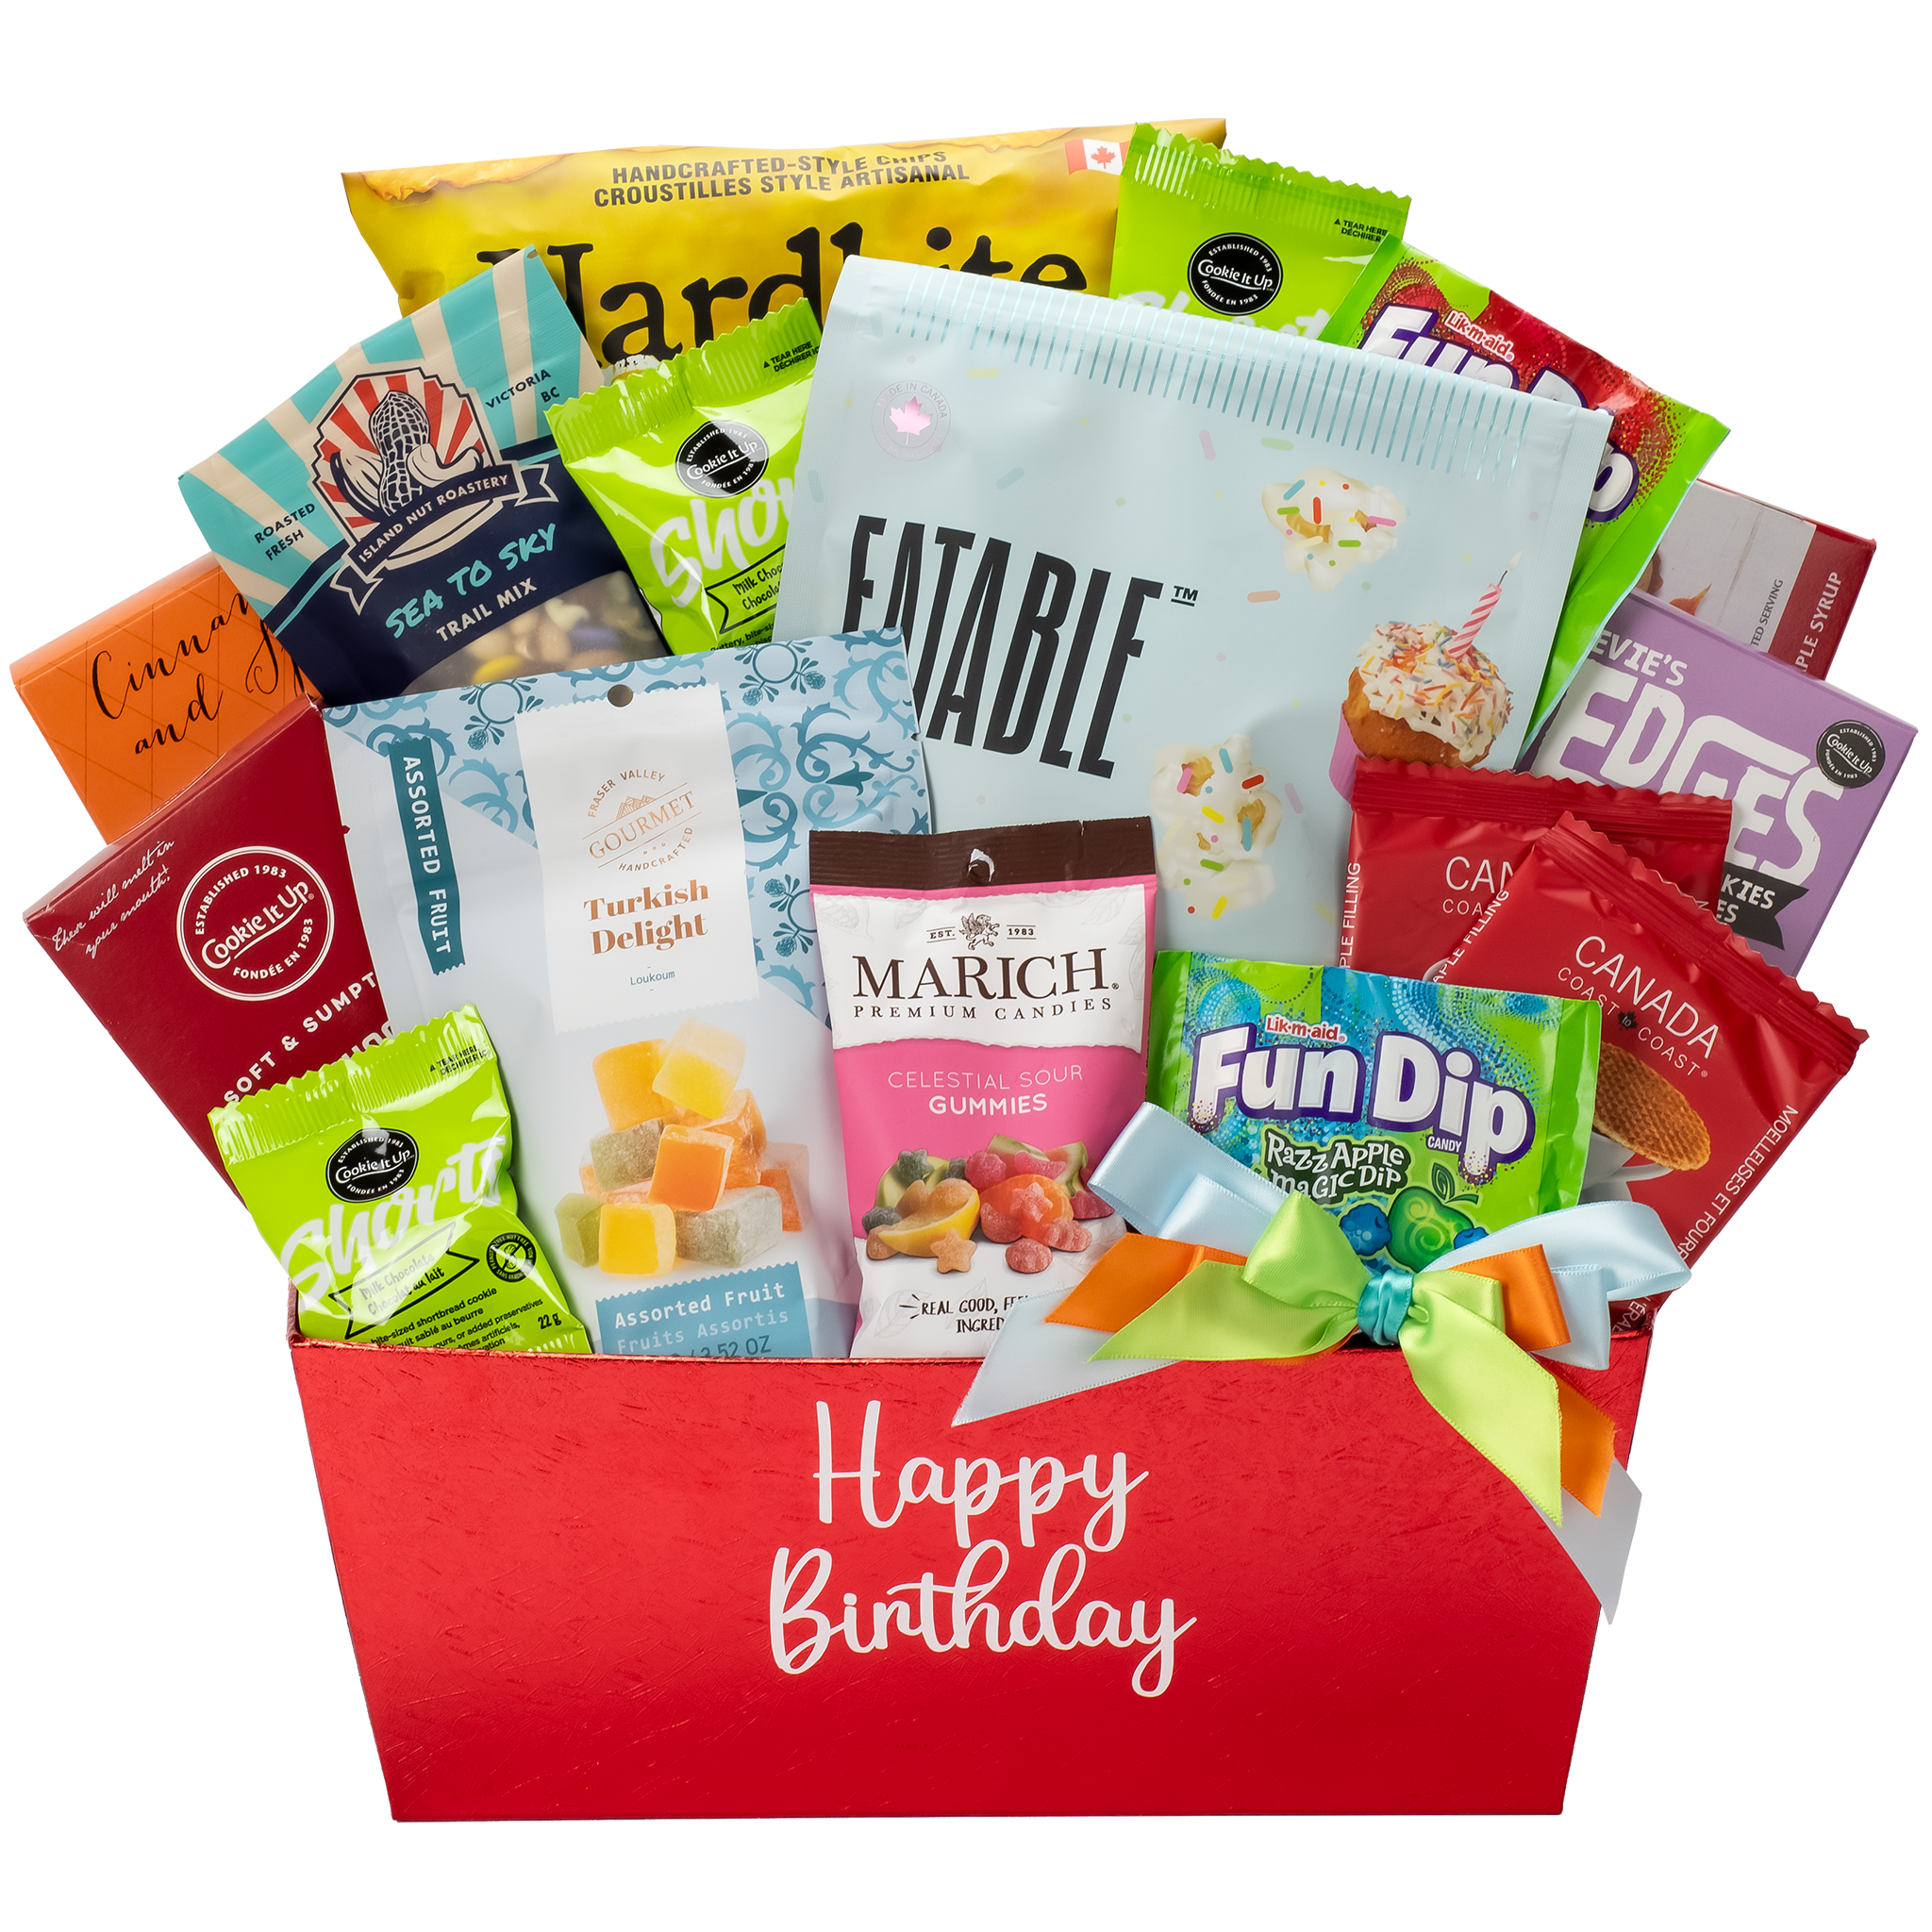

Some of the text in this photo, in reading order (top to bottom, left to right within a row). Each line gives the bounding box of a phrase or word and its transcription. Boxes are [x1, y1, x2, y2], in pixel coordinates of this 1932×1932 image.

[594, 164, 970, 207] CROUSTILLES STYLE ARTISANAL
[612, 151, 947, 184] HANDCRAFTED-STYLE CHIPS
[1343, 220, 1365, 231] TEAR
[1197, 259, 1274, 291] Cookie It Up
[1208, 243, 1272, 273] ESTABLISHED 1983
[1201, 279, 1224, 303] FONDÉE
[1240, 294, 1258, 305] 1983
[770, 341, 812, 364] TEAR HERE
[485, 369, 552, 408] VICTORIA
[541, 386, 560, 403] BC
[921, 385, 948, 418] CANADA
[687, 428, 725, 462] ESTABLISHED
[687, 441, 758, 480] Cookie It Up
[701, 480, 731, 489] FONDÉE
[732, 475, 743, 484] EN
[254, 503, 316, 544] ROASTED
[358, 475, 509, 563] ISLAND NUT ROASTERY
[264, 529, 304, 561] FRESH
[385, 523, 556, 639] SEA TO SKY
[732, 576, 758, 595] Milk
[436, 578, 538, 641] TRAIL MIX
[1759, 579, 1783, 625] SERVING
[1810, 572, 1841, 632] SYRUP
[841, 514, 1165, 780] EATABLE
[135, 673, 224, 755] and
[1826, 734, 1873, 774] Cookie It Up
[1840, 728, 1874, 746] ESTABLISHED
[588, 769, 665, 818] FRASER VALLEY
[589, 791, 695, 859] GOURMET
[403, 757, 452, 954] ASSORTED FRUIT
[618, 826, 693, 872] HANDCRAFTED
[89, 841, 175, 921] will melt in
[195, 864, 287, 936] ESTABLISHED 1983
[583, 879, 710, 921] Turkish
[1343, 862, 1361, 929] FILLING
[202, 881, 309, 969] Cookie It Up
[590, 913, 708, 956] Delight
[929, 927, 1035, 941] EST. 1983
[1463, 890, 1509, 944] FILLING
[86, 923, 118, 959] your
[233, 918, 313, 979] FONDÉE EN 1983
[630, 970, 676, 986] Loukoum
[1557, 967, 1621, 1016] COAST
[1622, 1015, 1632, 1026] to
[1574, 935, 1720, 1059] CANADA
[853, 997, 1111, 1020] PREMIUM CANDIES
[224, 1051, 276, 1104] SOFT
[281, 1035, 299, 1052] &
[888, 1064, 1083, 1091] CELESTIAL SOUR
[928, 1092, 1048, 1117] GUMMIES
[1191, 1024, 1532, 1178] Fun Dip
[338, 1137, 384, 1163] ESTABLISHED
[1427, 1136, 1462, 1153] CANDY
[1724, 1105, 1799, 1195] MOELLEUSES
[336, 1150, 410, 1184] Cookie It Up
[347, 1184, 375, 1194] FONDÉE
[1711, 1192, 1731, 1215] ET
[359, 1254, 435, 1300] Milk Chocolate
[368, 1267, 445, 1315] Chocolat au lait
[415, 1307, 484, 1341] sablé au beurre
[416, 1300, 466, 1327] shortbread
[467, 1288, 497, 1305] cookie
[468, 1319, 493, 1335] added
[494, 1298, 543, 1324] preservatives
[538, 1312, 561, 1330] 22 g
[615, 1282, 785, 1329] Assorted Fruit
[921, 1298, 998, 1315] REAL GOOD,
[481, 1323, 520, 1340] artificiels,
[617, 1308, 789, 1355] Fruits Assortis
[745, 1335, 772, 1356] OZ
[813, 1400, 1149, 1553] Happy
[769, 1539, 1198, 1697] Birthday
